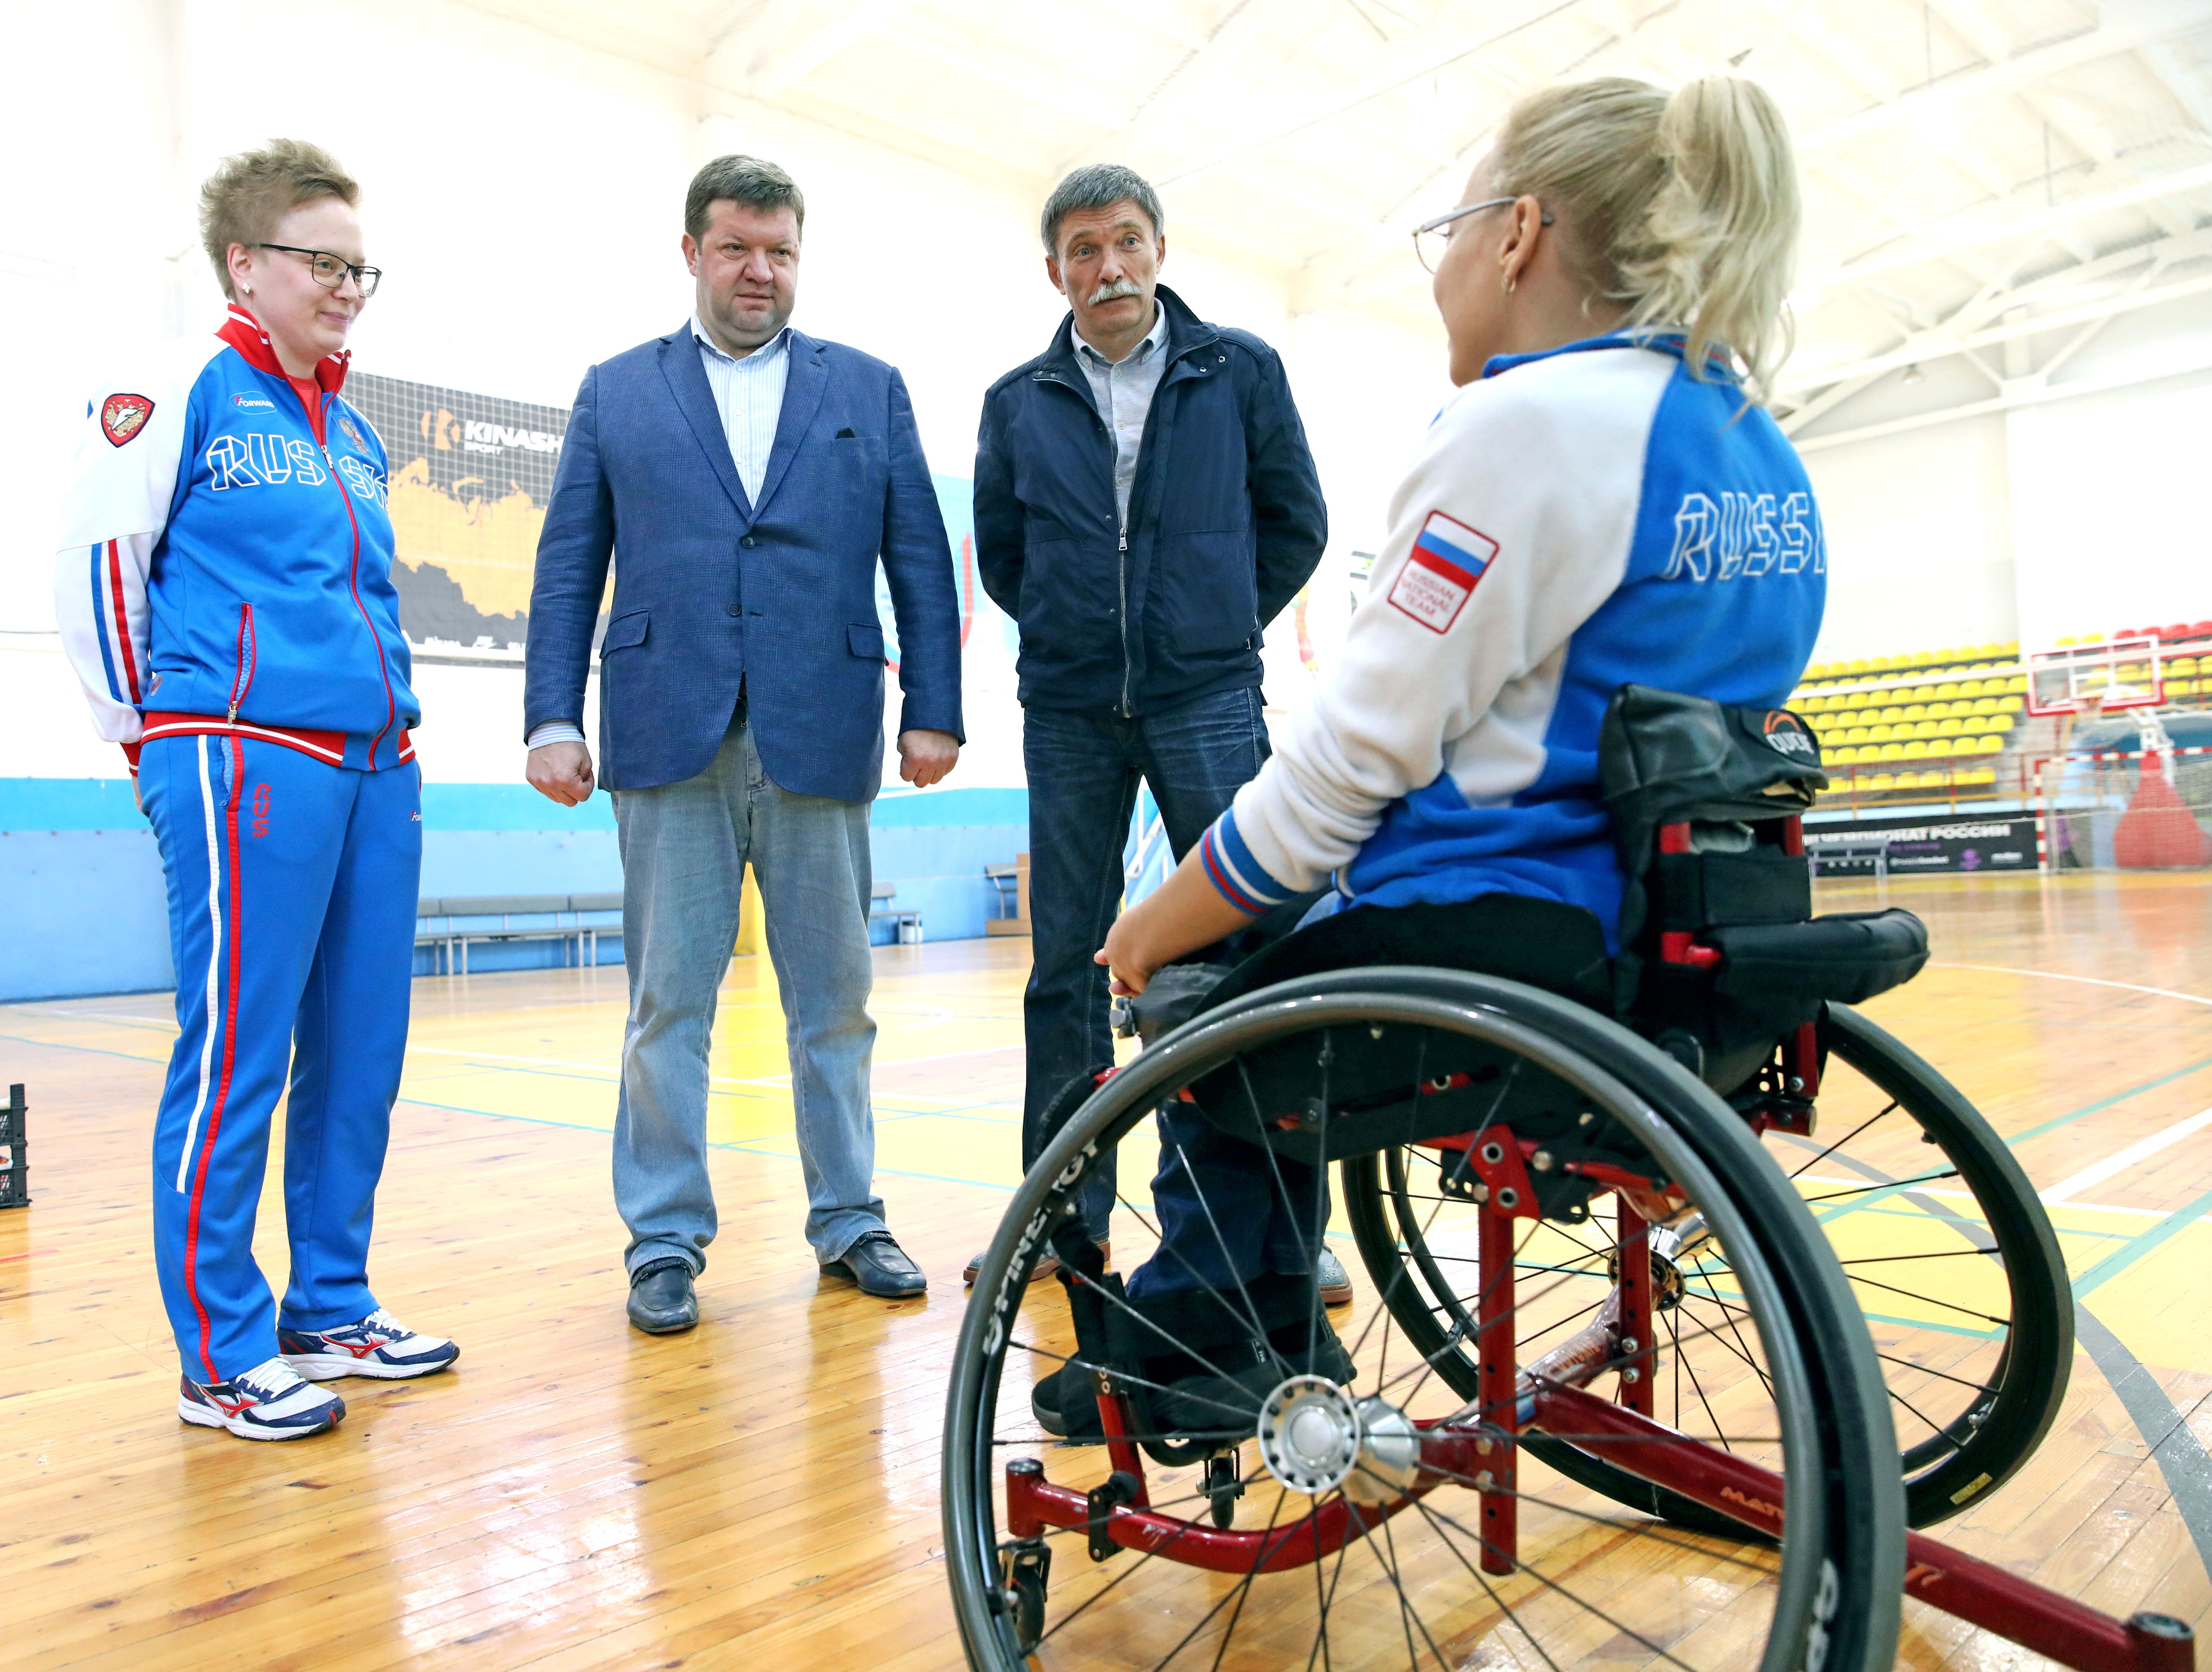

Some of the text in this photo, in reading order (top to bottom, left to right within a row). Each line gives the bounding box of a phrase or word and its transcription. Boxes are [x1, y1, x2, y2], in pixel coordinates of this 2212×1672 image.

[235, 396, 275, 408] FORWARD
[464, 441, 503, 455] SPORT
[1405, 593, 1435, 617] TEAM
[252, 783, 272, 837] RUS
[1929, 823, 2011, 840] РОССИИ
[982, 1138, 1099, 1357] SPINEGY
